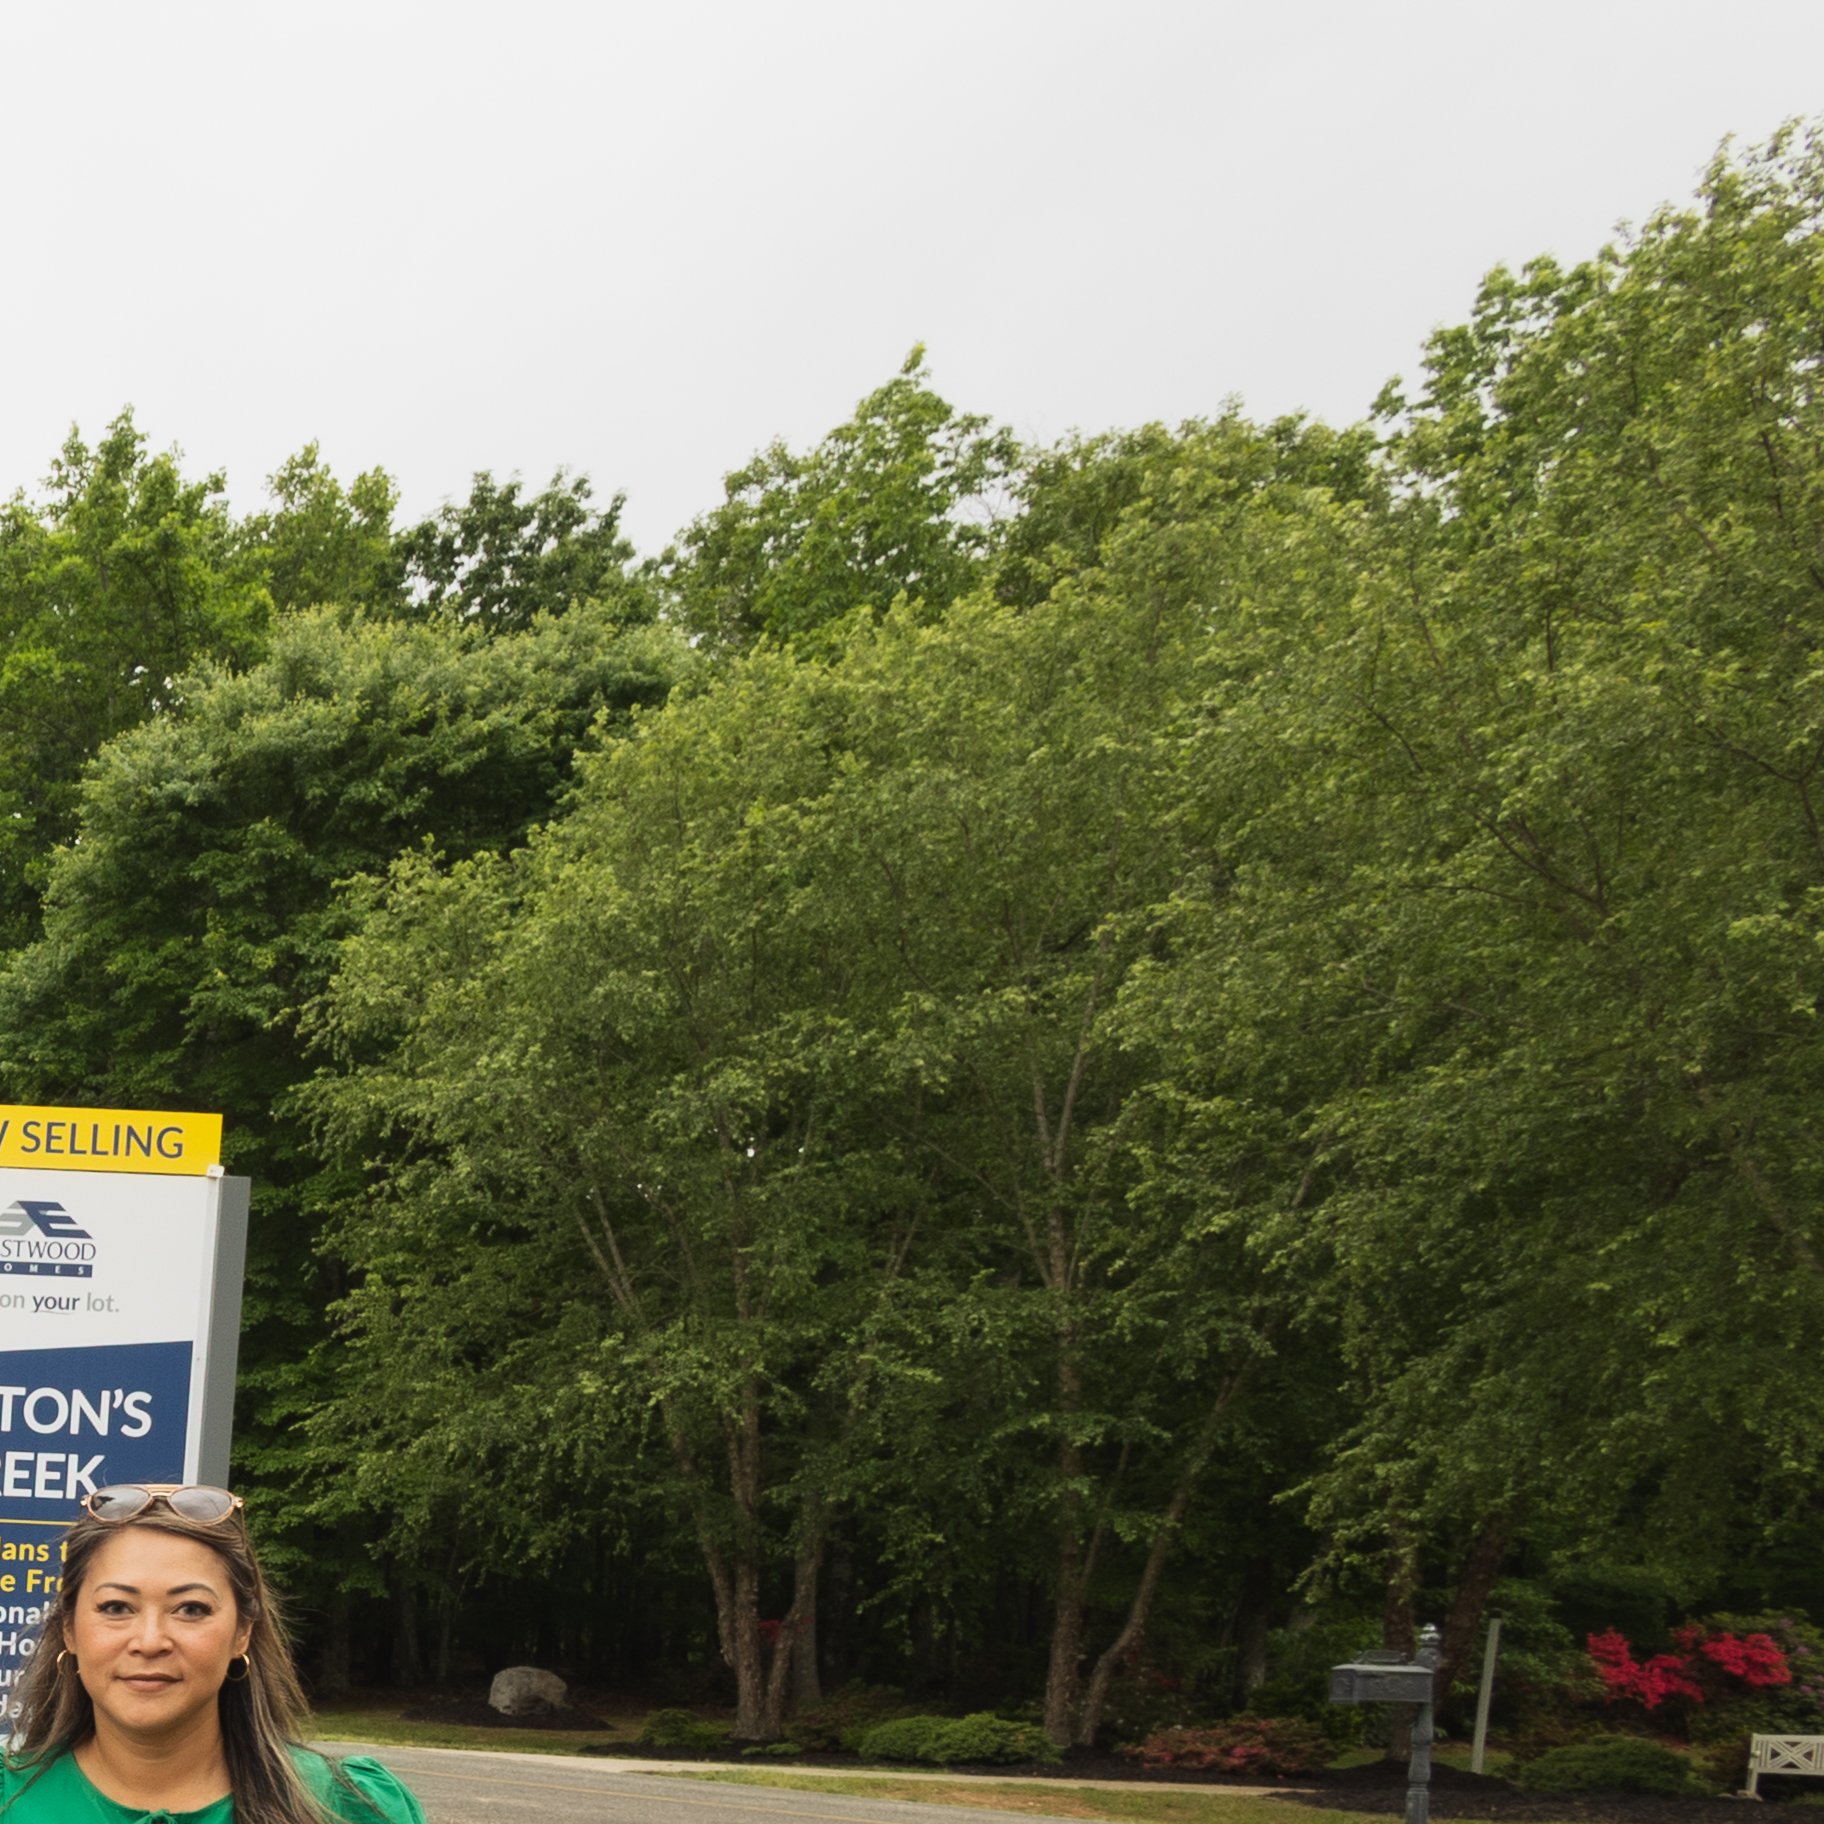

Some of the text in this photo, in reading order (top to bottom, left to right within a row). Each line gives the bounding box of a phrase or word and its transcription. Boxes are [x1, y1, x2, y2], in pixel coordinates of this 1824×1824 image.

[20, 1120, 184, 1159] SELLING
[32, 1295, 80, 1313] your
[86, 1292, 120, 1313] lot.
[26, 1569, 64, 1594] Fr
